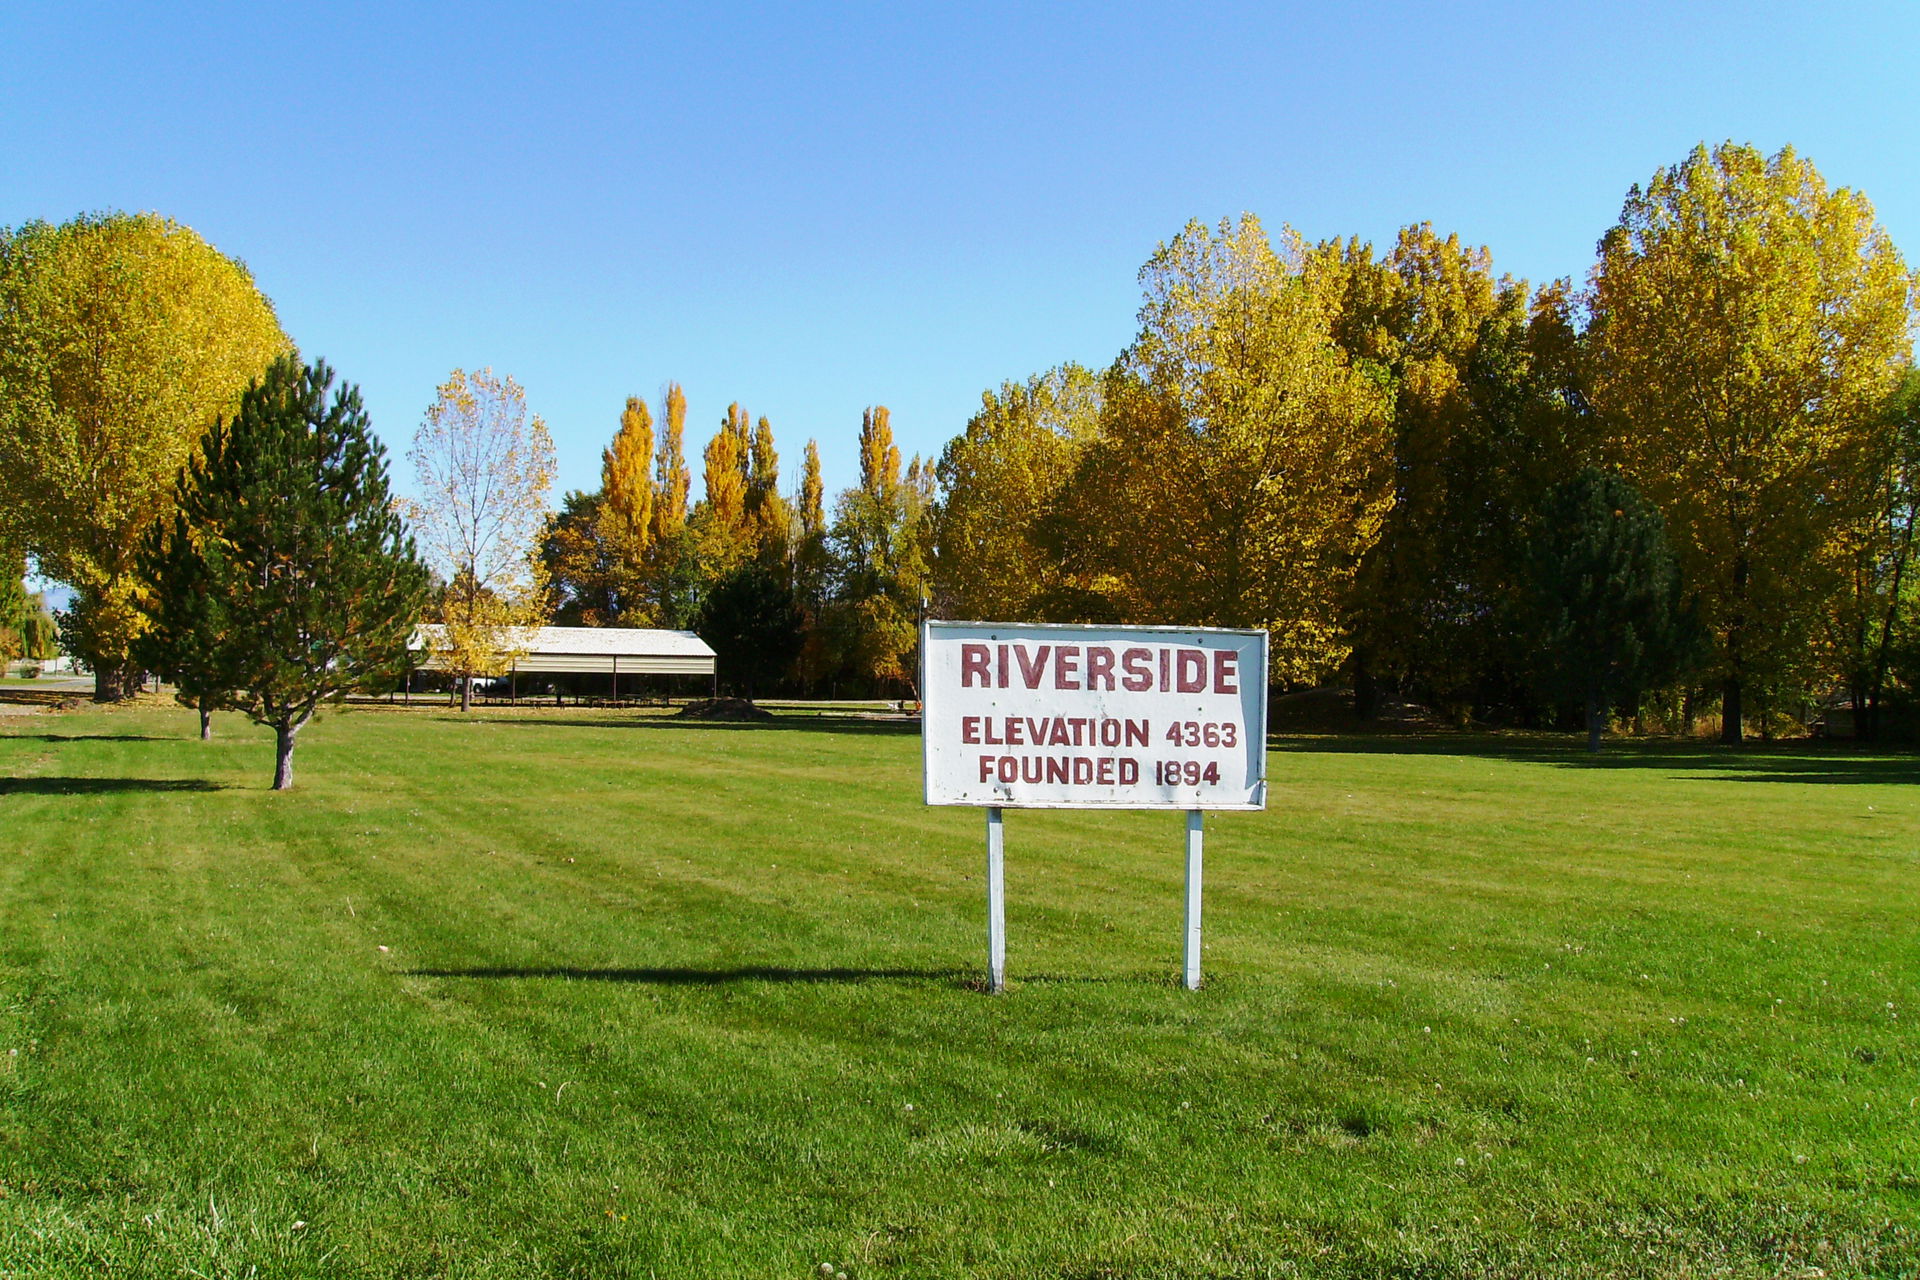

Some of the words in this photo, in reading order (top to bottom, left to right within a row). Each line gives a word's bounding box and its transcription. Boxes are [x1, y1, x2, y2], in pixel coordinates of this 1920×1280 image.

[961, 644, 1238, 694] RIVERSIDE
[962, 716, 1149, 747] ELEVATION
[1166, 721, 1237, 747] 4363
[979, 755, 1138, 785] FOUNDED
[1156, 760, 1220, 785] 1894
